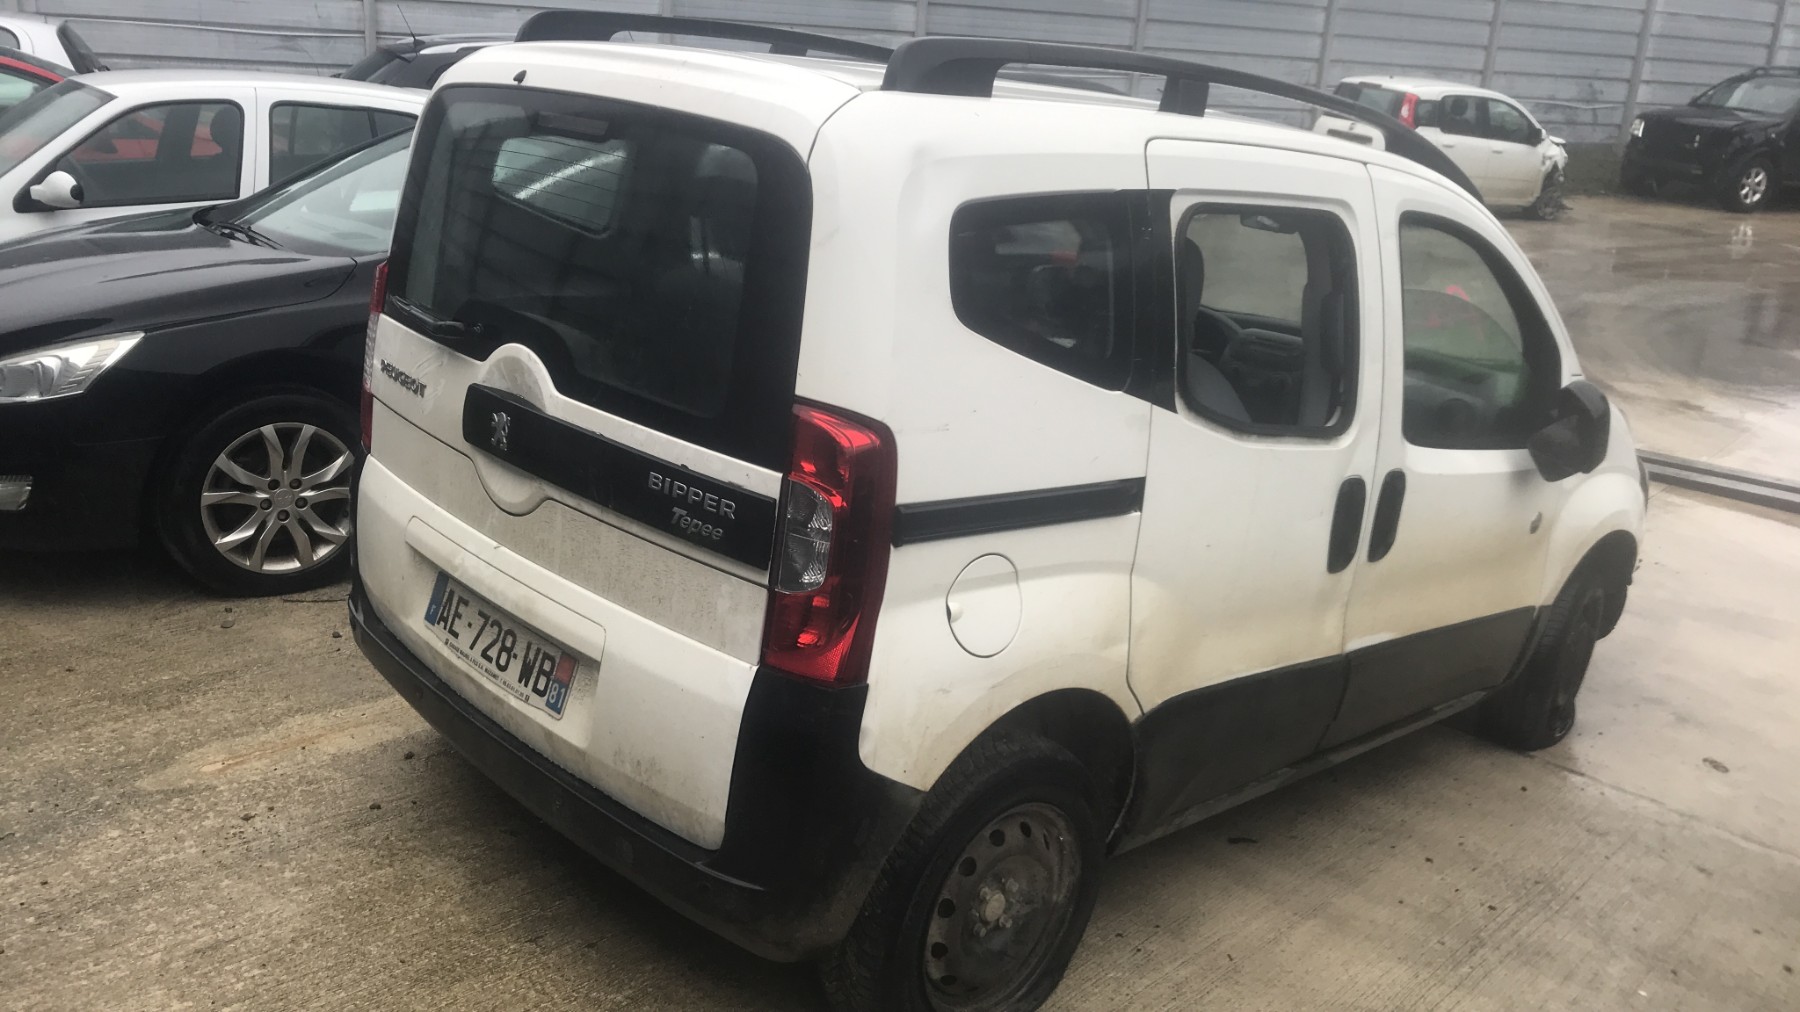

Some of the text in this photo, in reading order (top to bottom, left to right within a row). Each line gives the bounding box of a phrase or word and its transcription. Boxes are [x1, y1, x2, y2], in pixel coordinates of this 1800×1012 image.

[381, 359, 427, 398] PEUGEOT
[648, 471, 736, 519] BIPPER
[671, 506, 723, 539] Tepee
[436, 588, 556, 698] AE-728-WB
[548, 682, 566, 708] 81
